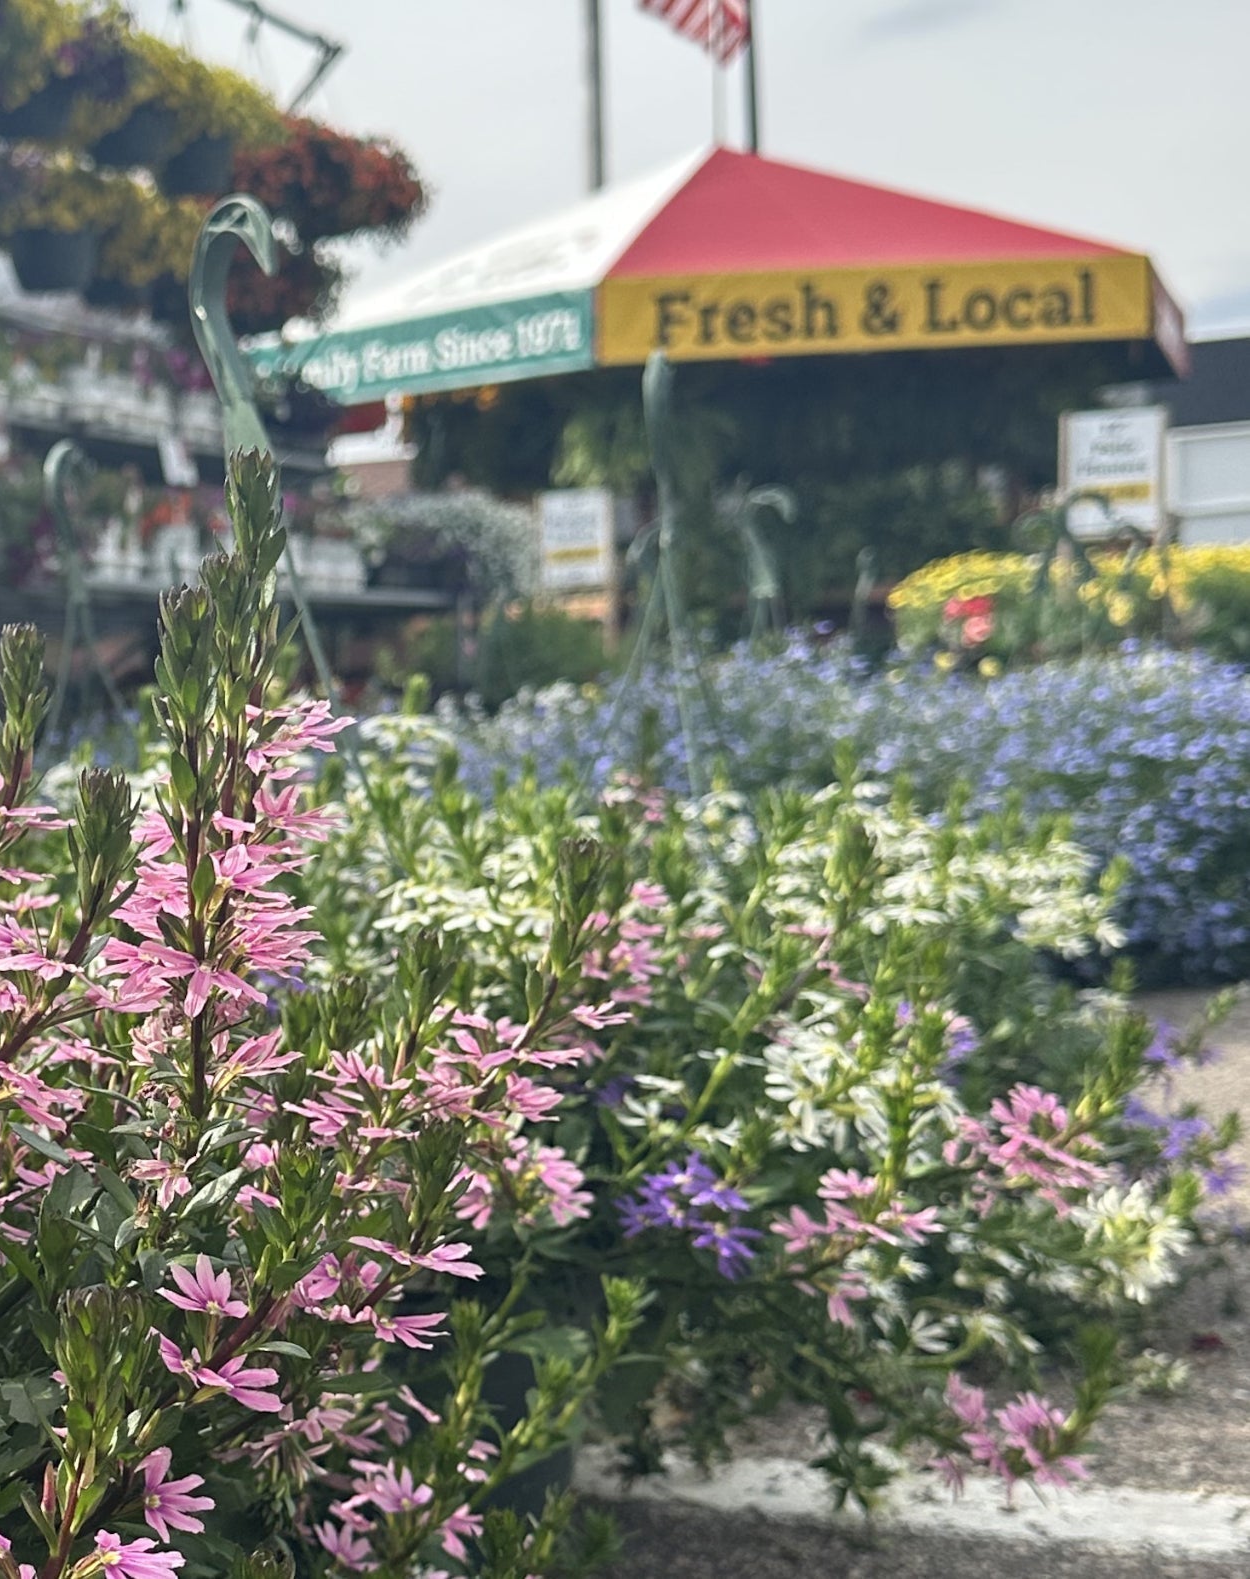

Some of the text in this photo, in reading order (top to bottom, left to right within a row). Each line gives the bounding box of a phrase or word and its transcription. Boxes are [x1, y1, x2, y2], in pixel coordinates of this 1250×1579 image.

[656, 266, 1095, 345] Fresh & Local
[363, 340, 433, 382] Farm
[434, 325, 512, 370] Since
